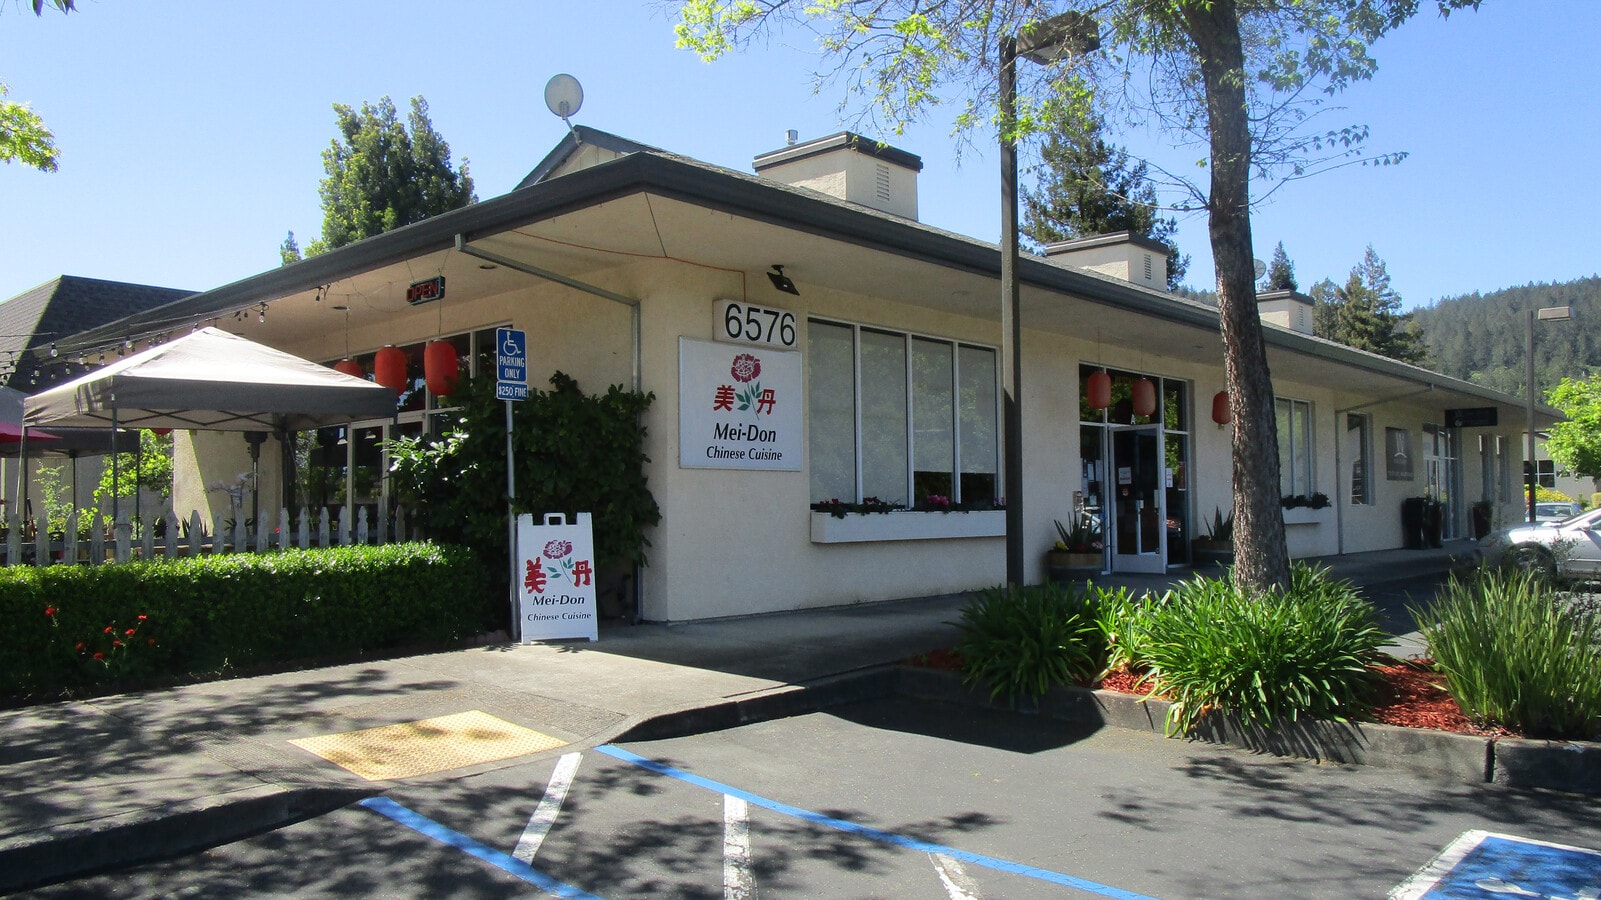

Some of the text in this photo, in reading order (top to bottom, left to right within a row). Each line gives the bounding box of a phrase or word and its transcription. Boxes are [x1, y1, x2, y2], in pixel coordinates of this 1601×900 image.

[407, 281, 438, 302] OPEN
[725, 303, 796, 346] 6576
[499, 355, 525, 368] PARKING
[504, 368, 520, 379] ONLY
[498, 385, 527, 397] $250 FINE
[713, 422, 776, 443] Mei-Don
[706, 445, 783, 461] Chinese Cuisine
[532, 594, 585, 606] Mei-Don
[527, 611, 592, 621] Chinese Cuisine
